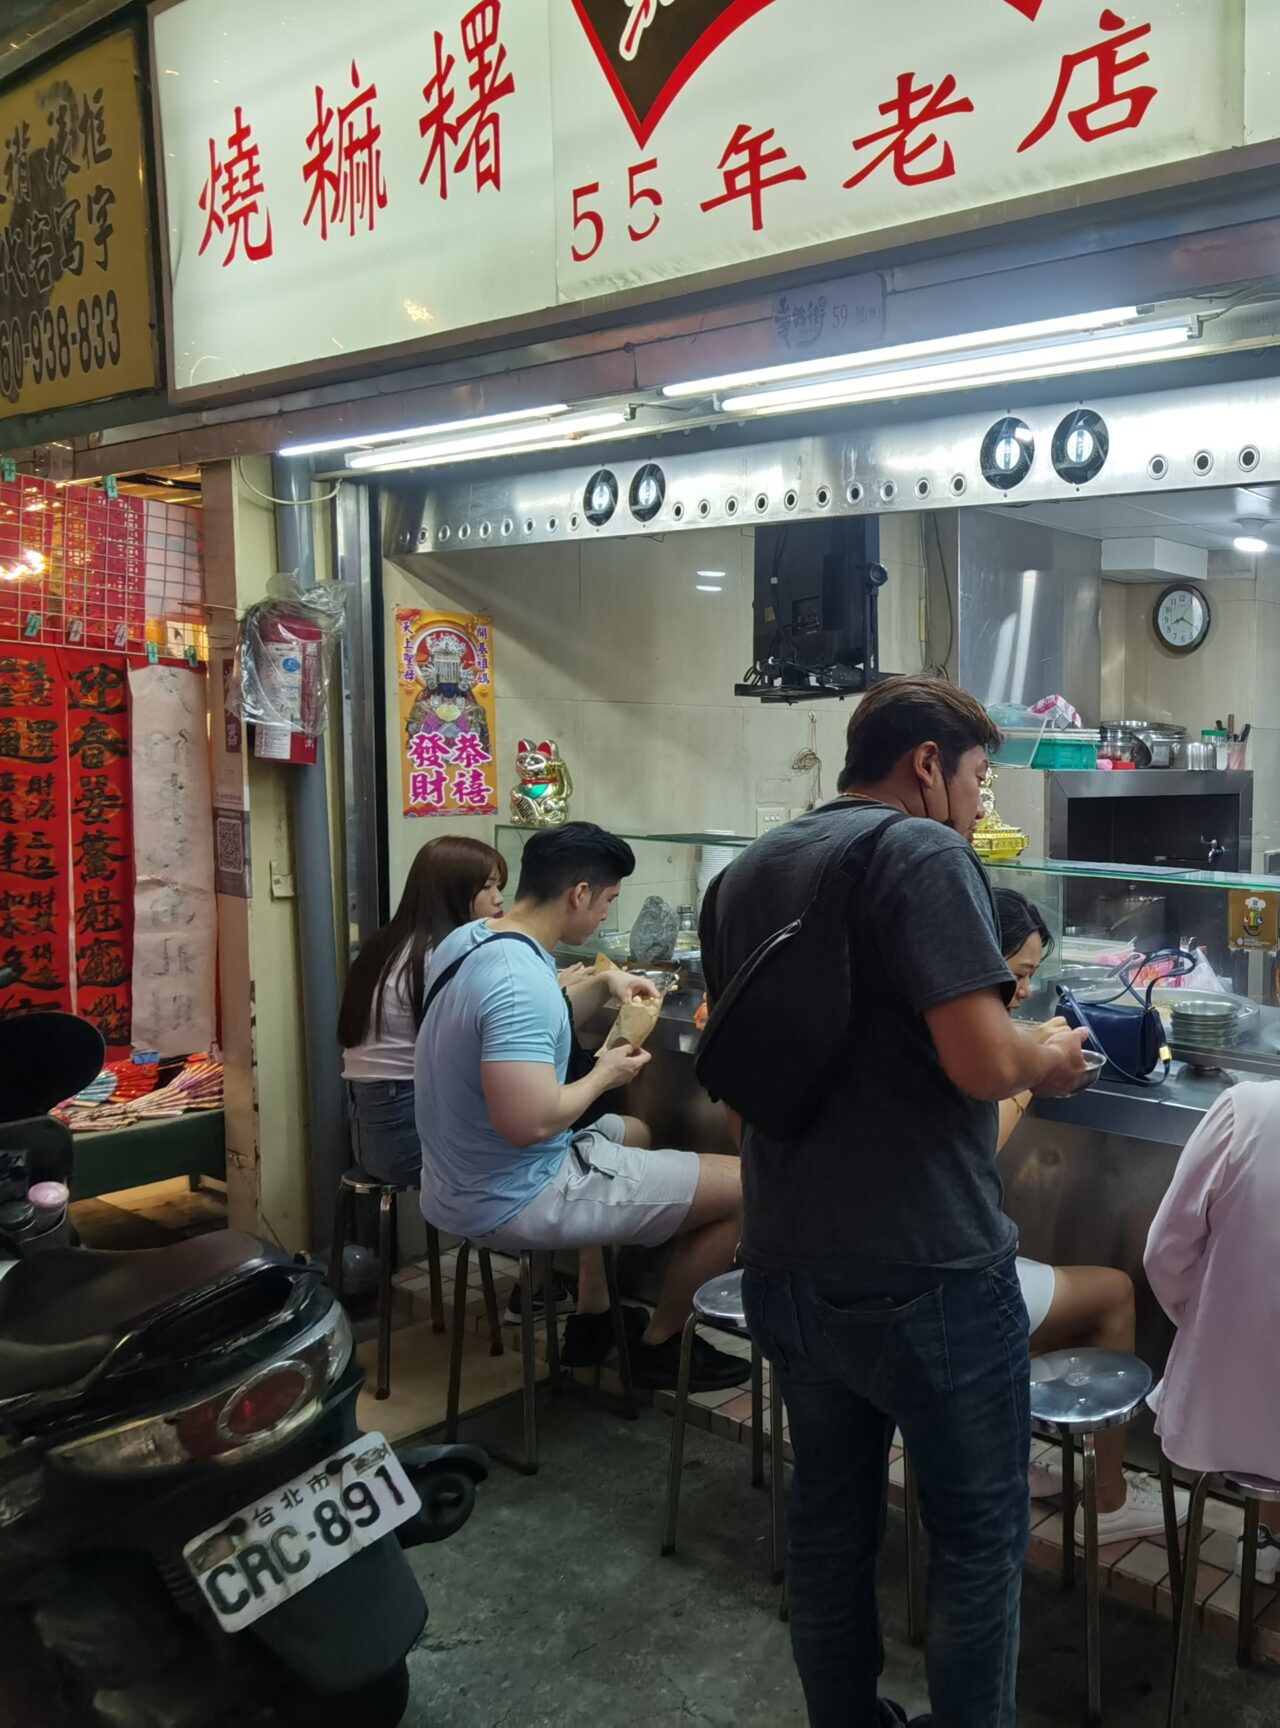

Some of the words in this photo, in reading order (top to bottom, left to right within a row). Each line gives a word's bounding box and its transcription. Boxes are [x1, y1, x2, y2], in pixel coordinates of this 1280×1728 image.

[570, 8, 1158, 262] 55年老店
[206, 1464, 406, 1616] CRC-891
[254, 1471, 331, 1528] 台北市
